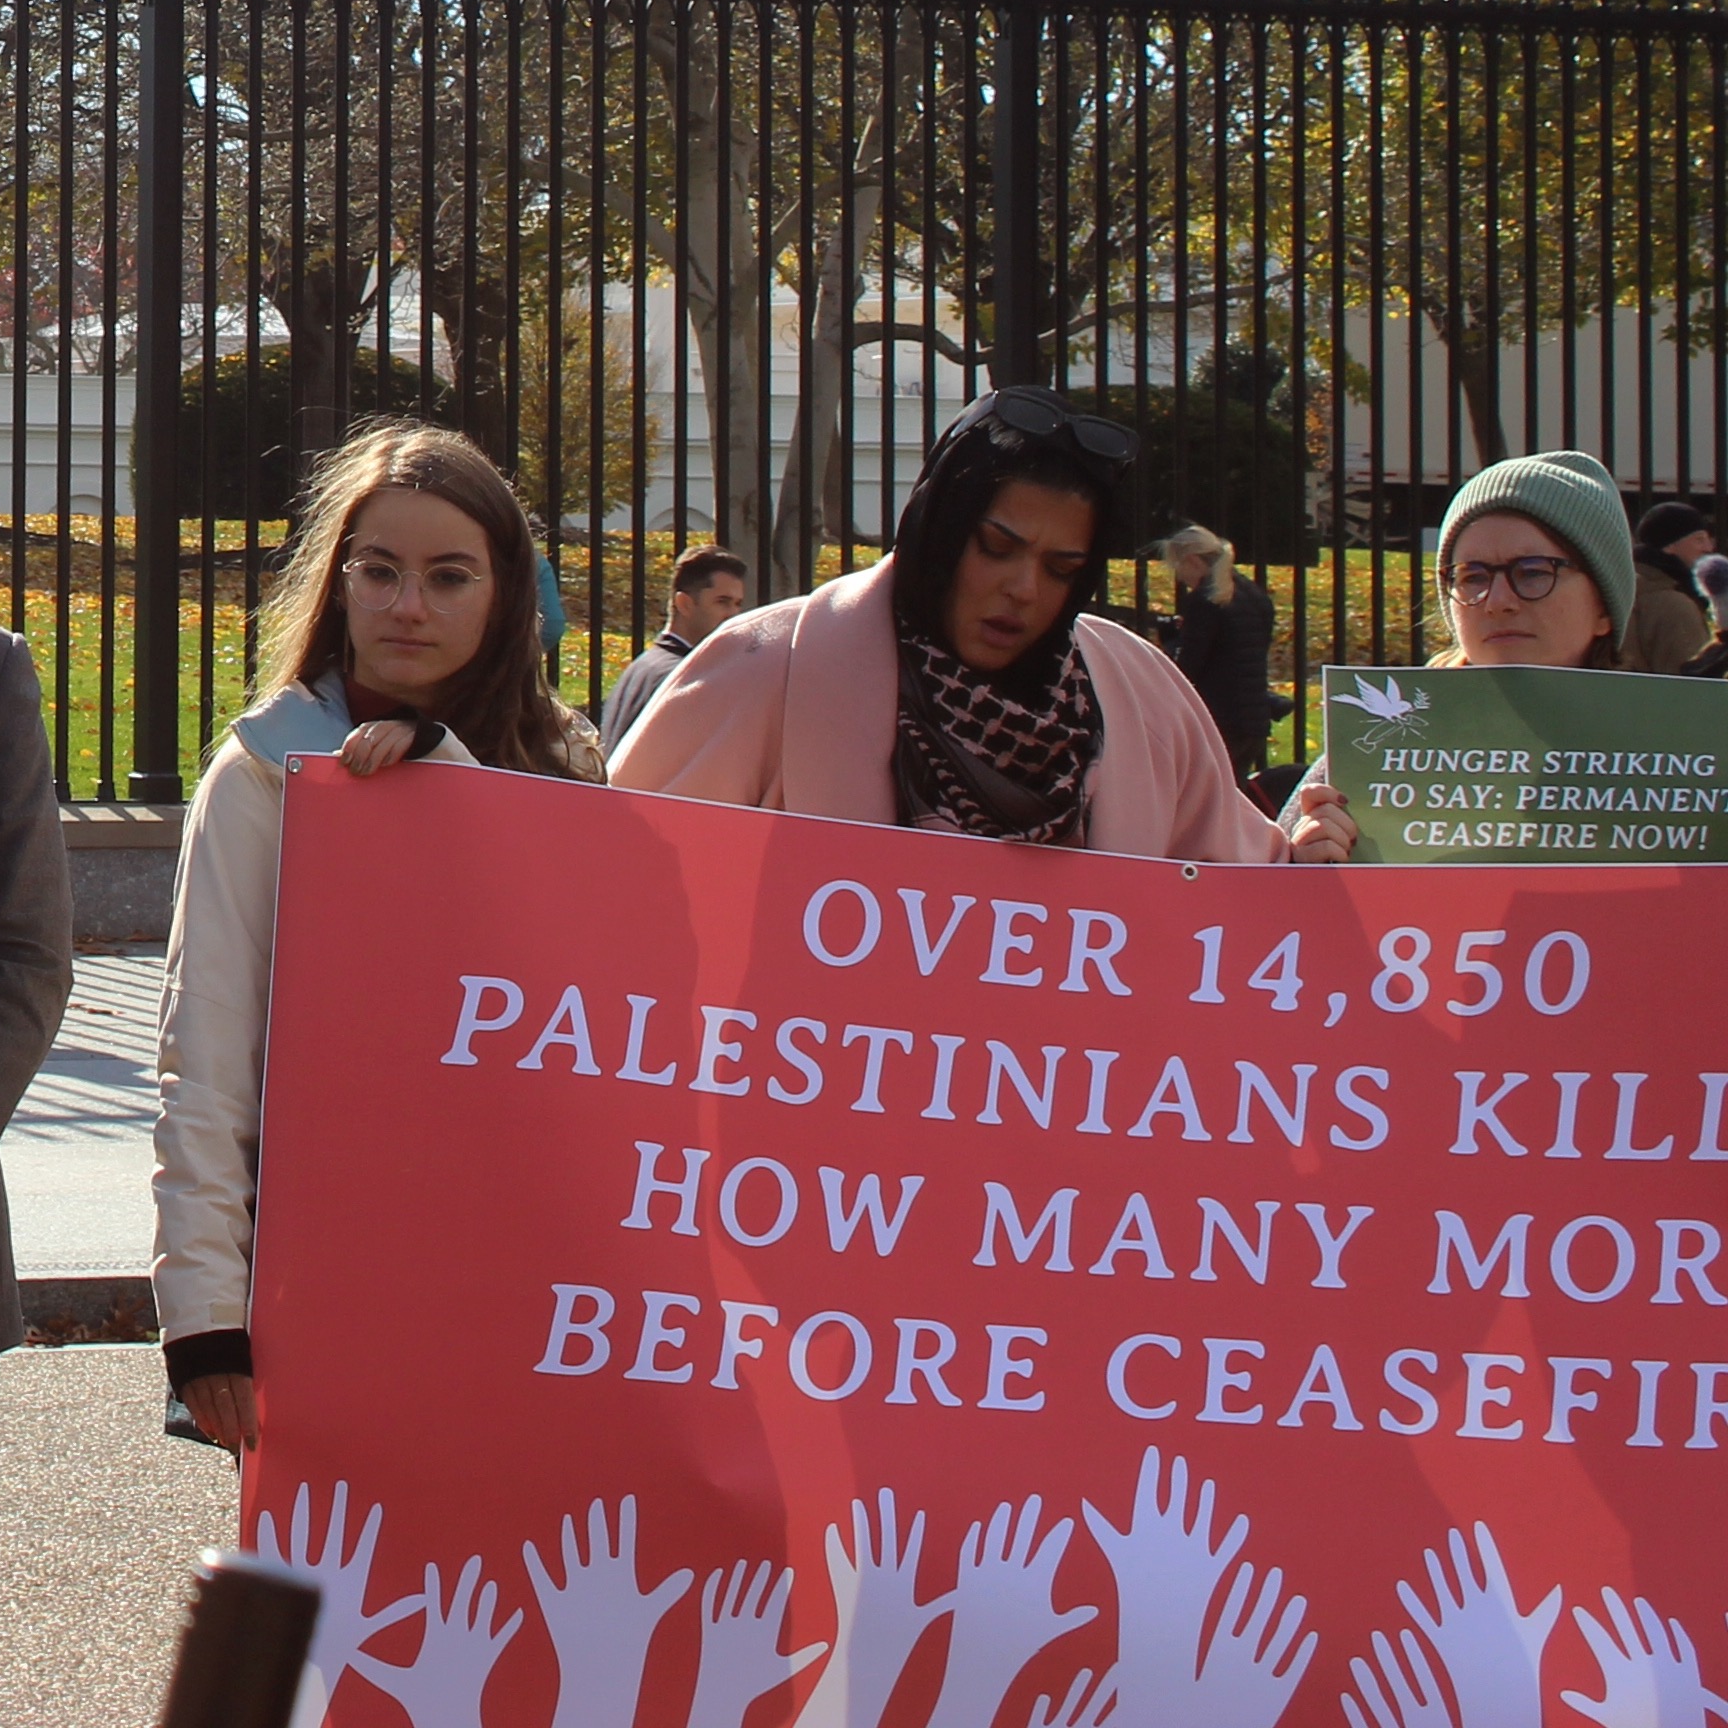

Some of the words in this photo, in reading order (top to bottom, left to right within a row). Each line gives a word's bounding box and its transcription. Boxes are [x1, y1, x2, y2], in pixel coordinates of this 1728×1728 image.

[1368, 782, 1416, 809] TO
[1425, 783, 1504, 810] SAY:
[1381, 748, 1531, 773] HUNGER
[1542, 750, 1716, 777] STRIKING
[1403, 821, 1598, 849] CEASEFIRE
[1609, 824, 1709, 851] NOW!
[802, 879, 1133, 997] OVER
[1188, 926, 1591, 1028] 14,850
[440, 974, 1390, 1152] PALESTINIANS
[1448, 1071, 1728, 1161] KILL
[620, 1140, 925, 1258] HOW
[972, 1181, 1375, 1290] MANY
[1427, 1210, 1728, 1306] MOR
[532, 1282, 1048, 1412] BEFORE
[1105, 1333, 1728, 1450] CEASEFIR
